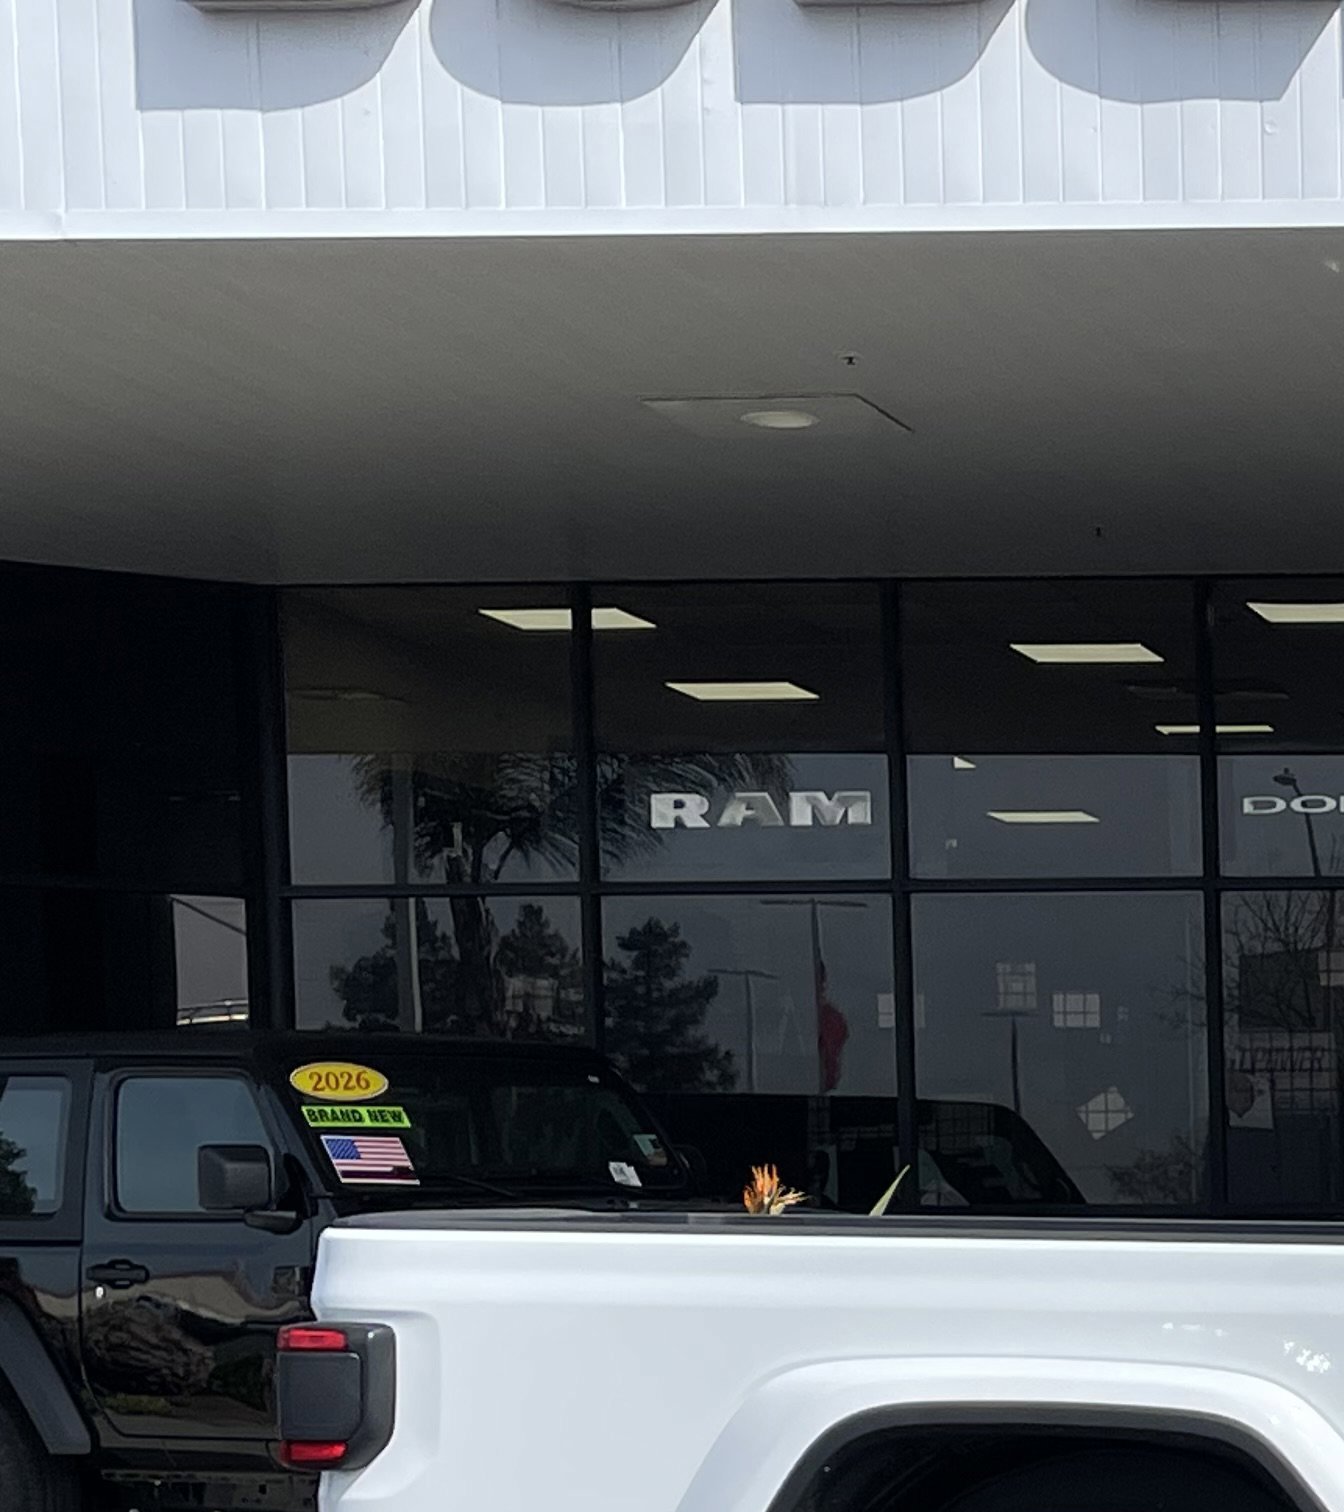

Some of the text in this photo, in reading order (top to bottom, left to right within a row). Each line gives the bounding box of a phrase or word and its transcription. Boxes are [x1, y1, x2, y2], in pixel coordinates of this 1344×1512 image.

[650, 791, 872, 829] RAM
[309, 1071, 371, 1092] 2026
[306, 1109, 405, 1124] BRAND NEW
